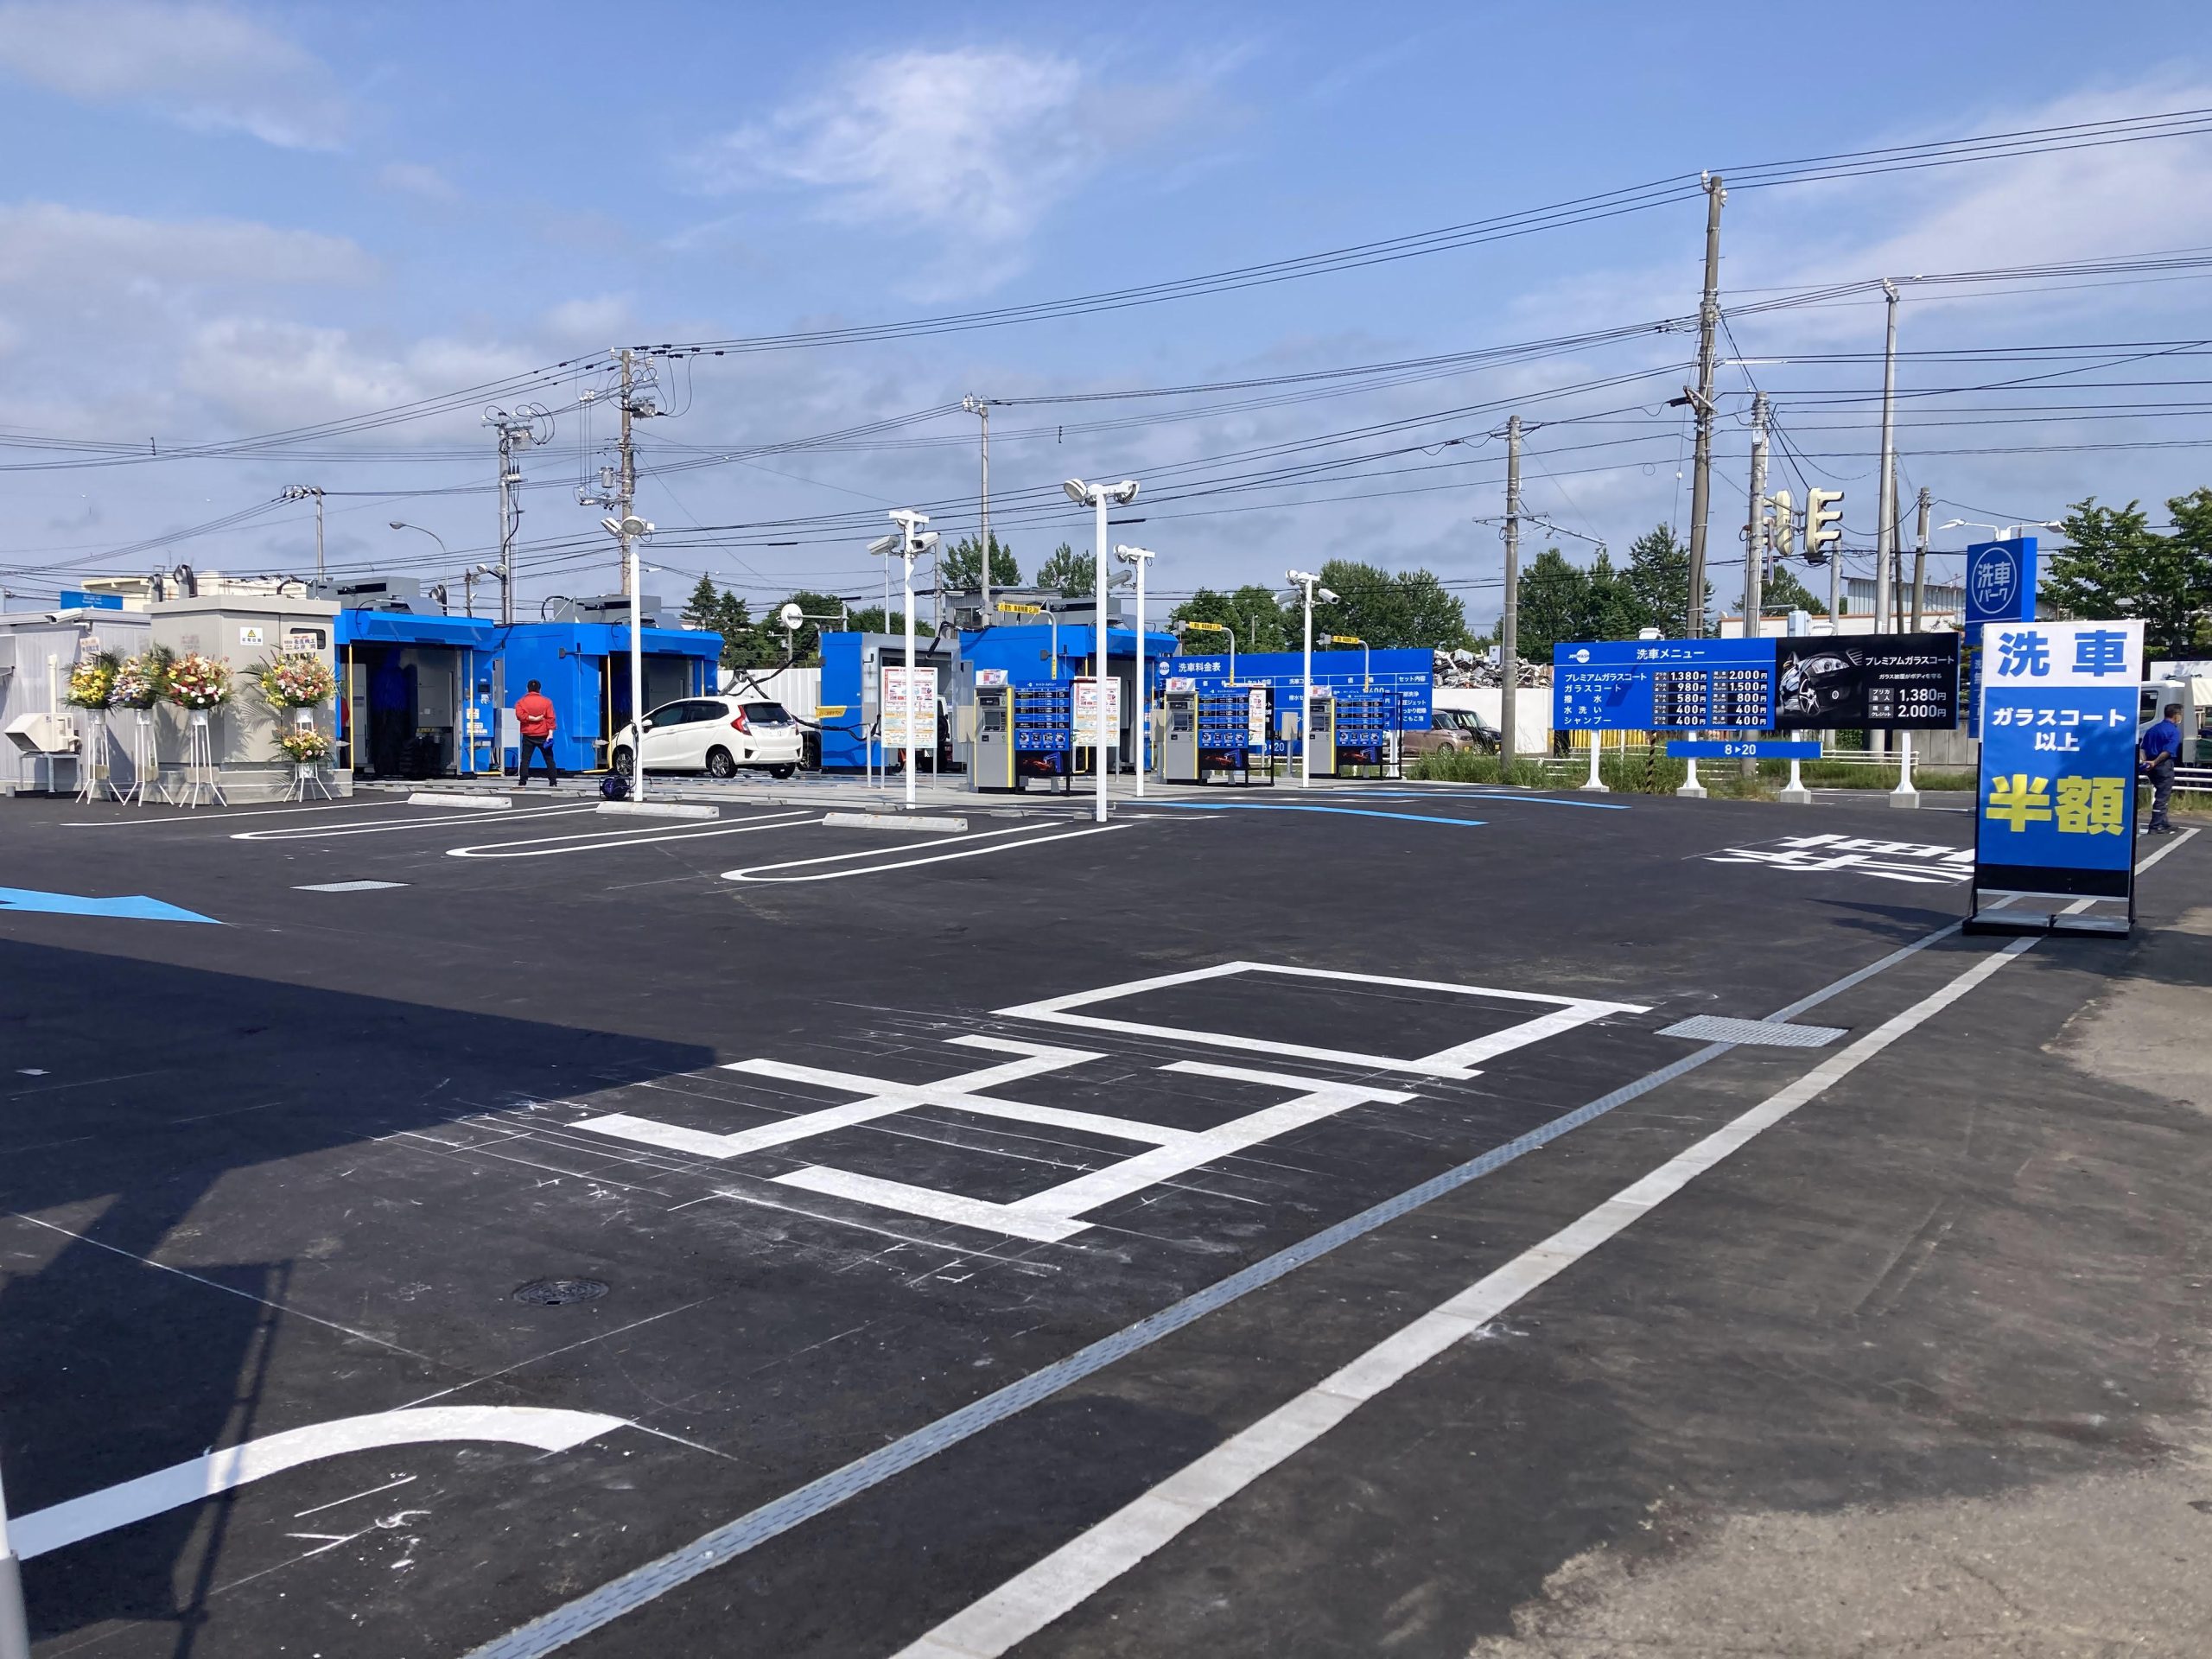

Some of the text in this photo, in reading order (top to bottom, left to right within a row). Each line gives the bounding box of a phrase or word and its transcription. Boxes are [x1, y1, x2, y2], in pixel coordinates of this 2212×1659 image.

[1977, 561, 2012, 588] 洗車
[1978, 588, 2008, 603] パーク
[1637, 648, 1706, 660] 洗車メニュー
[1997, 629, 2127, 677] 洗車
[1866, 655, 1955, 666] プレミアムガラスコート
[1178, 662, 1221, 673] 洗車料金表
[1565, 672, 1647, 682] プレミアムガラスコート
[1564, 684, 1622, 693] ガラスコート
[1677, 682, 1707, 691] 980円
[1677, 693, 1707, 702] 580円
[1737, 693, 1767, 702] 800円
[1899, 689, 1947, 702] 1,380円
[1563, 706, 1602, 715] 水洗い
[1676, 704, 1707, 714] 400円
[1736, 704, 1767, 714] 400円
[1564, 716, 1612, 725] シャンプー
[1676, 715, 1707, 725] 400円
[1736, 715, 1767, 725] 400円
[1992, 707, 2127, 728] ガラスコート
[2034, 732, 2080, 752] 以上
[1725, 744, 1757, 755] 8 20
[1986, 773, 2126, 836] 半額
